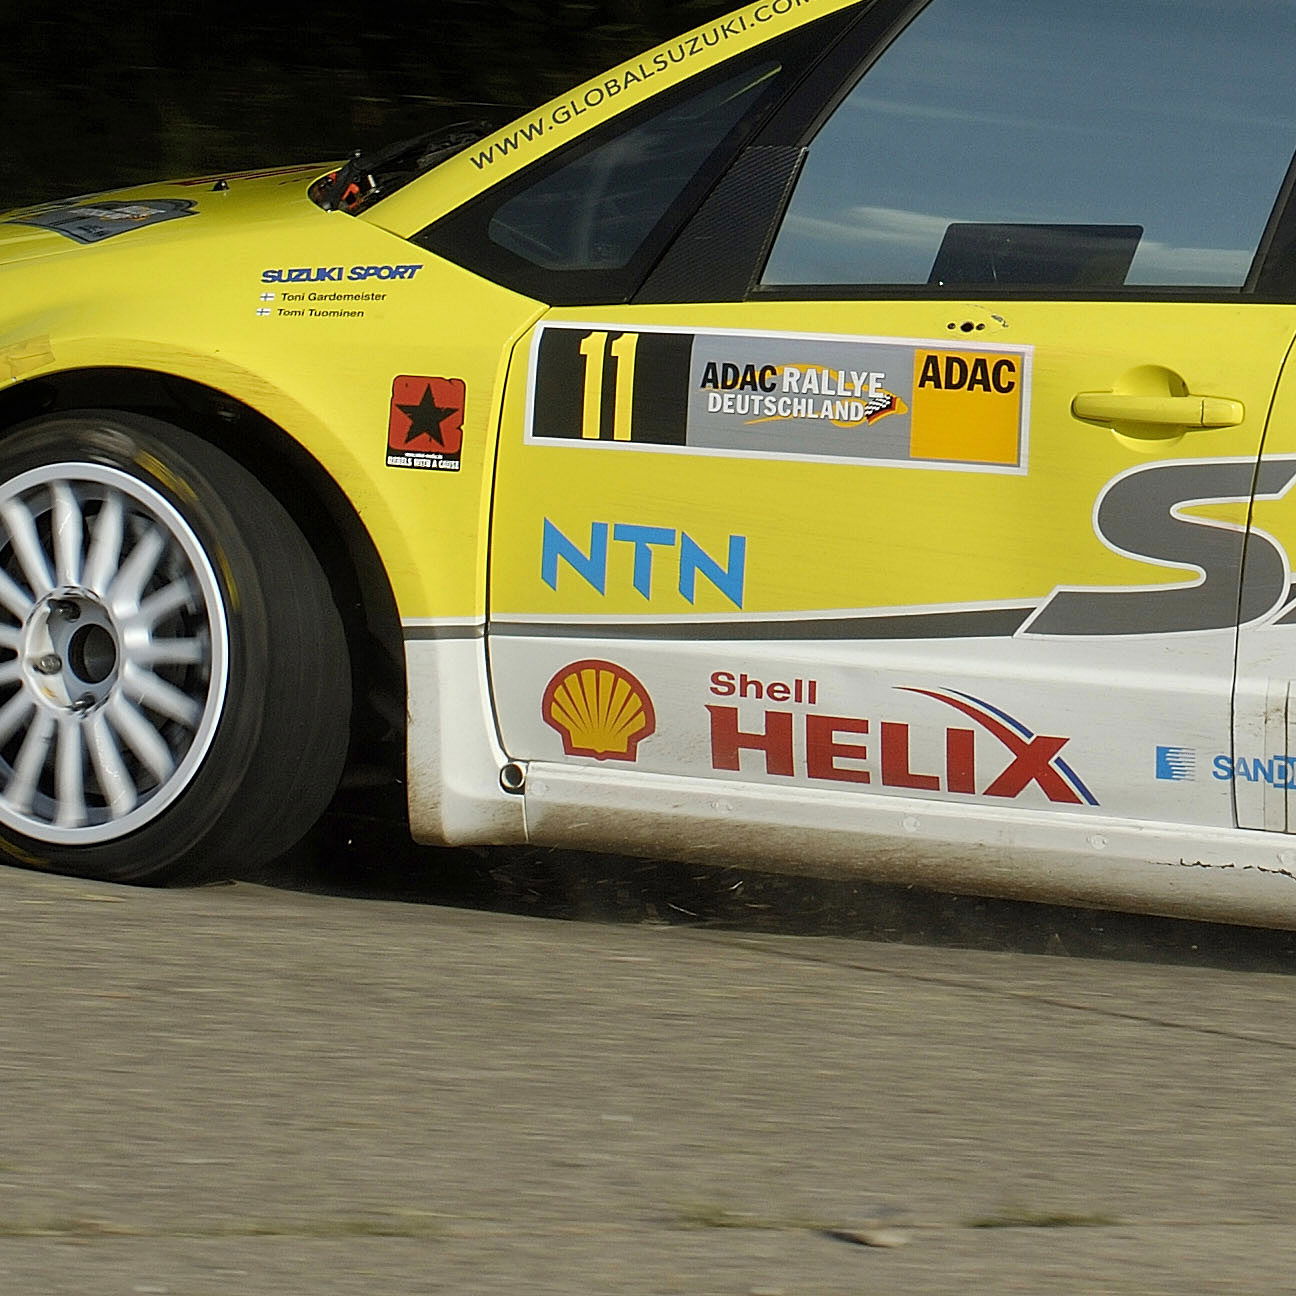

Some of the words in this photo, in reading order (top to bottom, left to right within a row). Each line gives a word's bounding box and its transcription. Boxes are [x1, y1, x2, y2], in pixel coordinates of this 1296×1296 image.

[260, 267, 344, 284] SUZUKI
[346, 264, 424, 281] SPORT
[277, 308, 305, 317] Tomi
[308, 308, 365, 318] Tuominen
[281, 292, 305, 302] Toni
[307, 291, 388, 302] Gardemeister
[578, 331, 640, 442] 11
[700, 361, 778, 393] ADAC
[781, 366, 887, 399] RALLYE
[917, 354, 1017, 395] ADAC
[706, 392, 867, 422] DEUTSCHLAND
[540, 516, 747, 610] NTN
[708, 671, 818, 705] Shell
[703, 687, 1086, 805] HELIX
